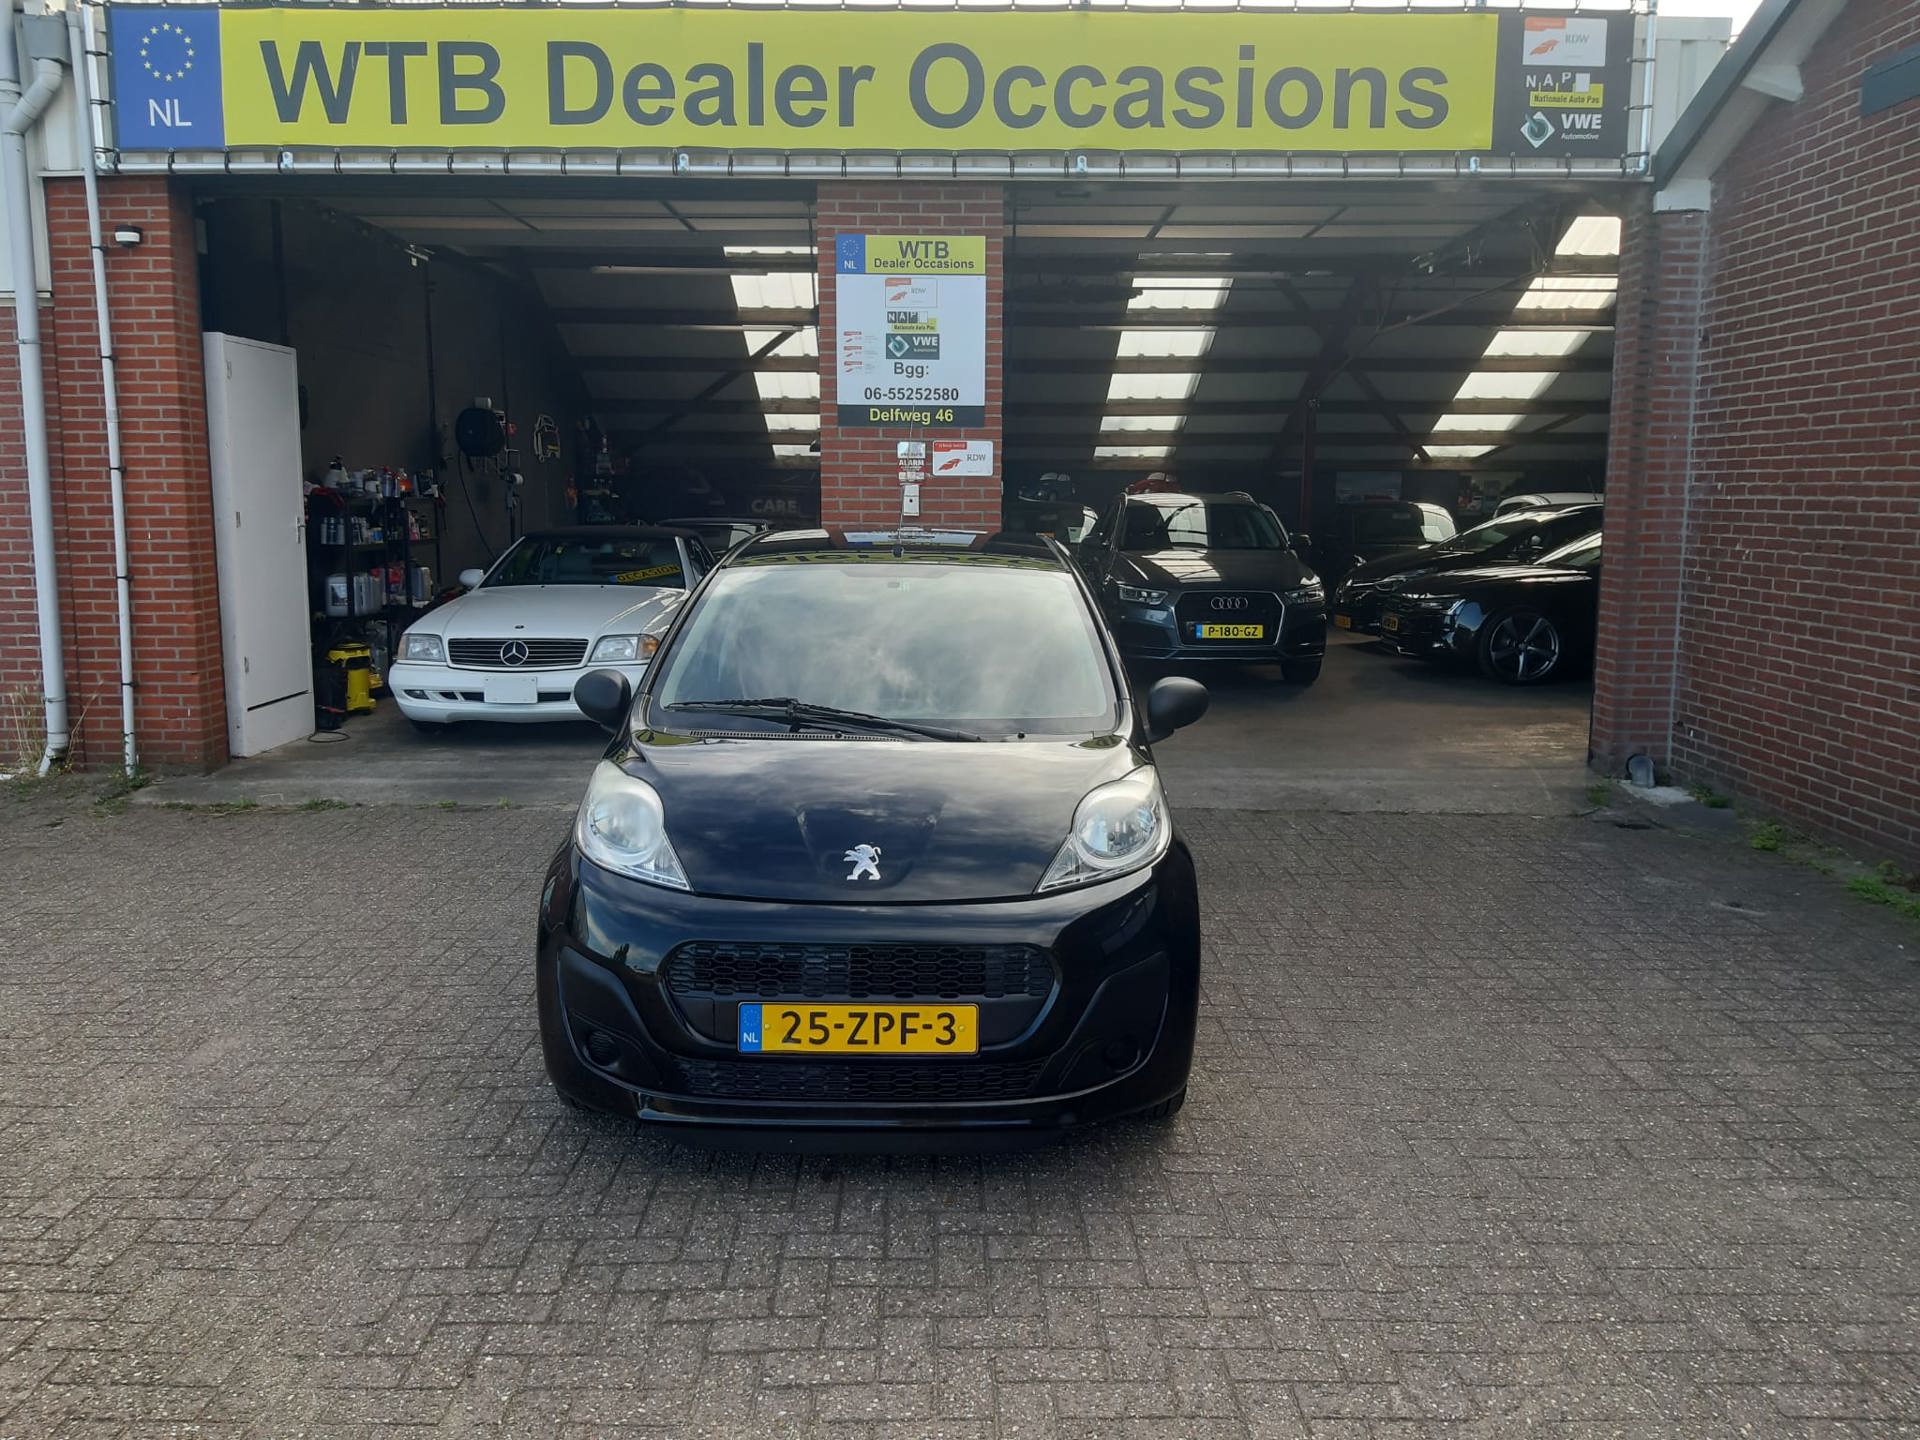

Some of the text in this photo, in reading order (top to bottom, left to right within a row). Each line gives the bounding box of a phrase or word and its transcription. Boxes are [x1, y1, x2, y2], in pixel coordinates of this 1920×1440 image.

[259, 40, 1449, 129] WTB Dealer Occasions
[1534, 95, 1567, 103] Nationale
[1569, 95, 1586, 104] Auto
[148, 98, 193, 127] NL
[1561, 113, 1602, 130] VWE
[1561, 133, 1599, 141] Automotive
[898, 240, 949, 259] WTB
[844, 260, 857, 270] NL
[874, 258, 974, 269] Dealer Occasions
[912, 336, 938, 347] VWE
[893, 362, 929, 378] Bgg:
[864, 387, 959, 401] 06-55252580
[869, 408, 953, 424] Delfweg 46
[966, 454, 986, 462] RDW
[751, 499, 798, 513] CARE
[1207, 626, 1258, 637] P-180-GZ
[780, 1010, 957, 1046] 25-ZPF-3
[743, 1033, 759, 1043] NL
